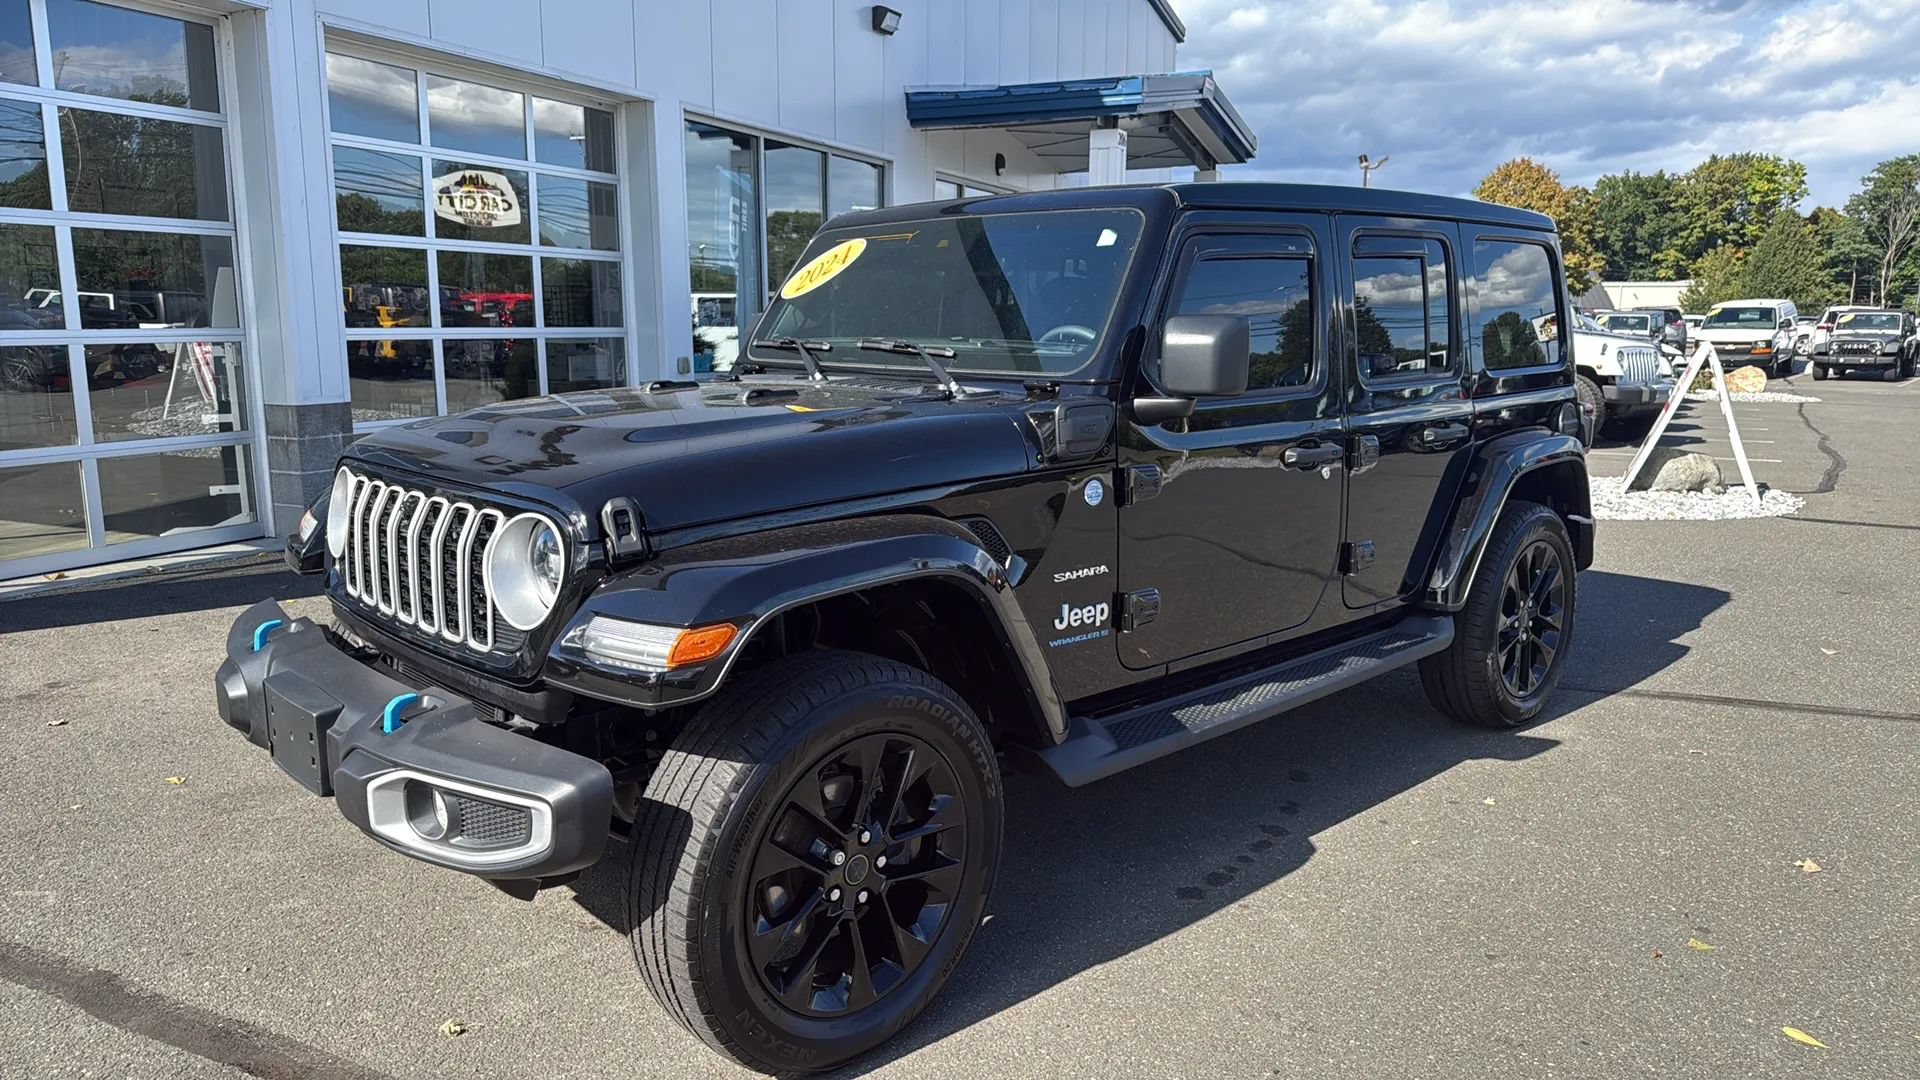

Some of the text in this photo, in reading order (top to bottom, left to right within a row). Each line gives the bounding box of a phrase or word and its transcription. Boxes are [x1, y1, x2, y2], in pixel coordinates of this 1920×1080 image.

[741, 200, 749, 233] TIRES
[795, 244, 853, 293] 2024
[1053, 564, 1109, 583] SAHARA
[1054, 601, 1109, 631] Jeep
[1048, 631, 1100, 648] WRANGLER
[887, 695, 972, 739] ROADIAN
[735, 1007, 817, 1063] NEXEN
